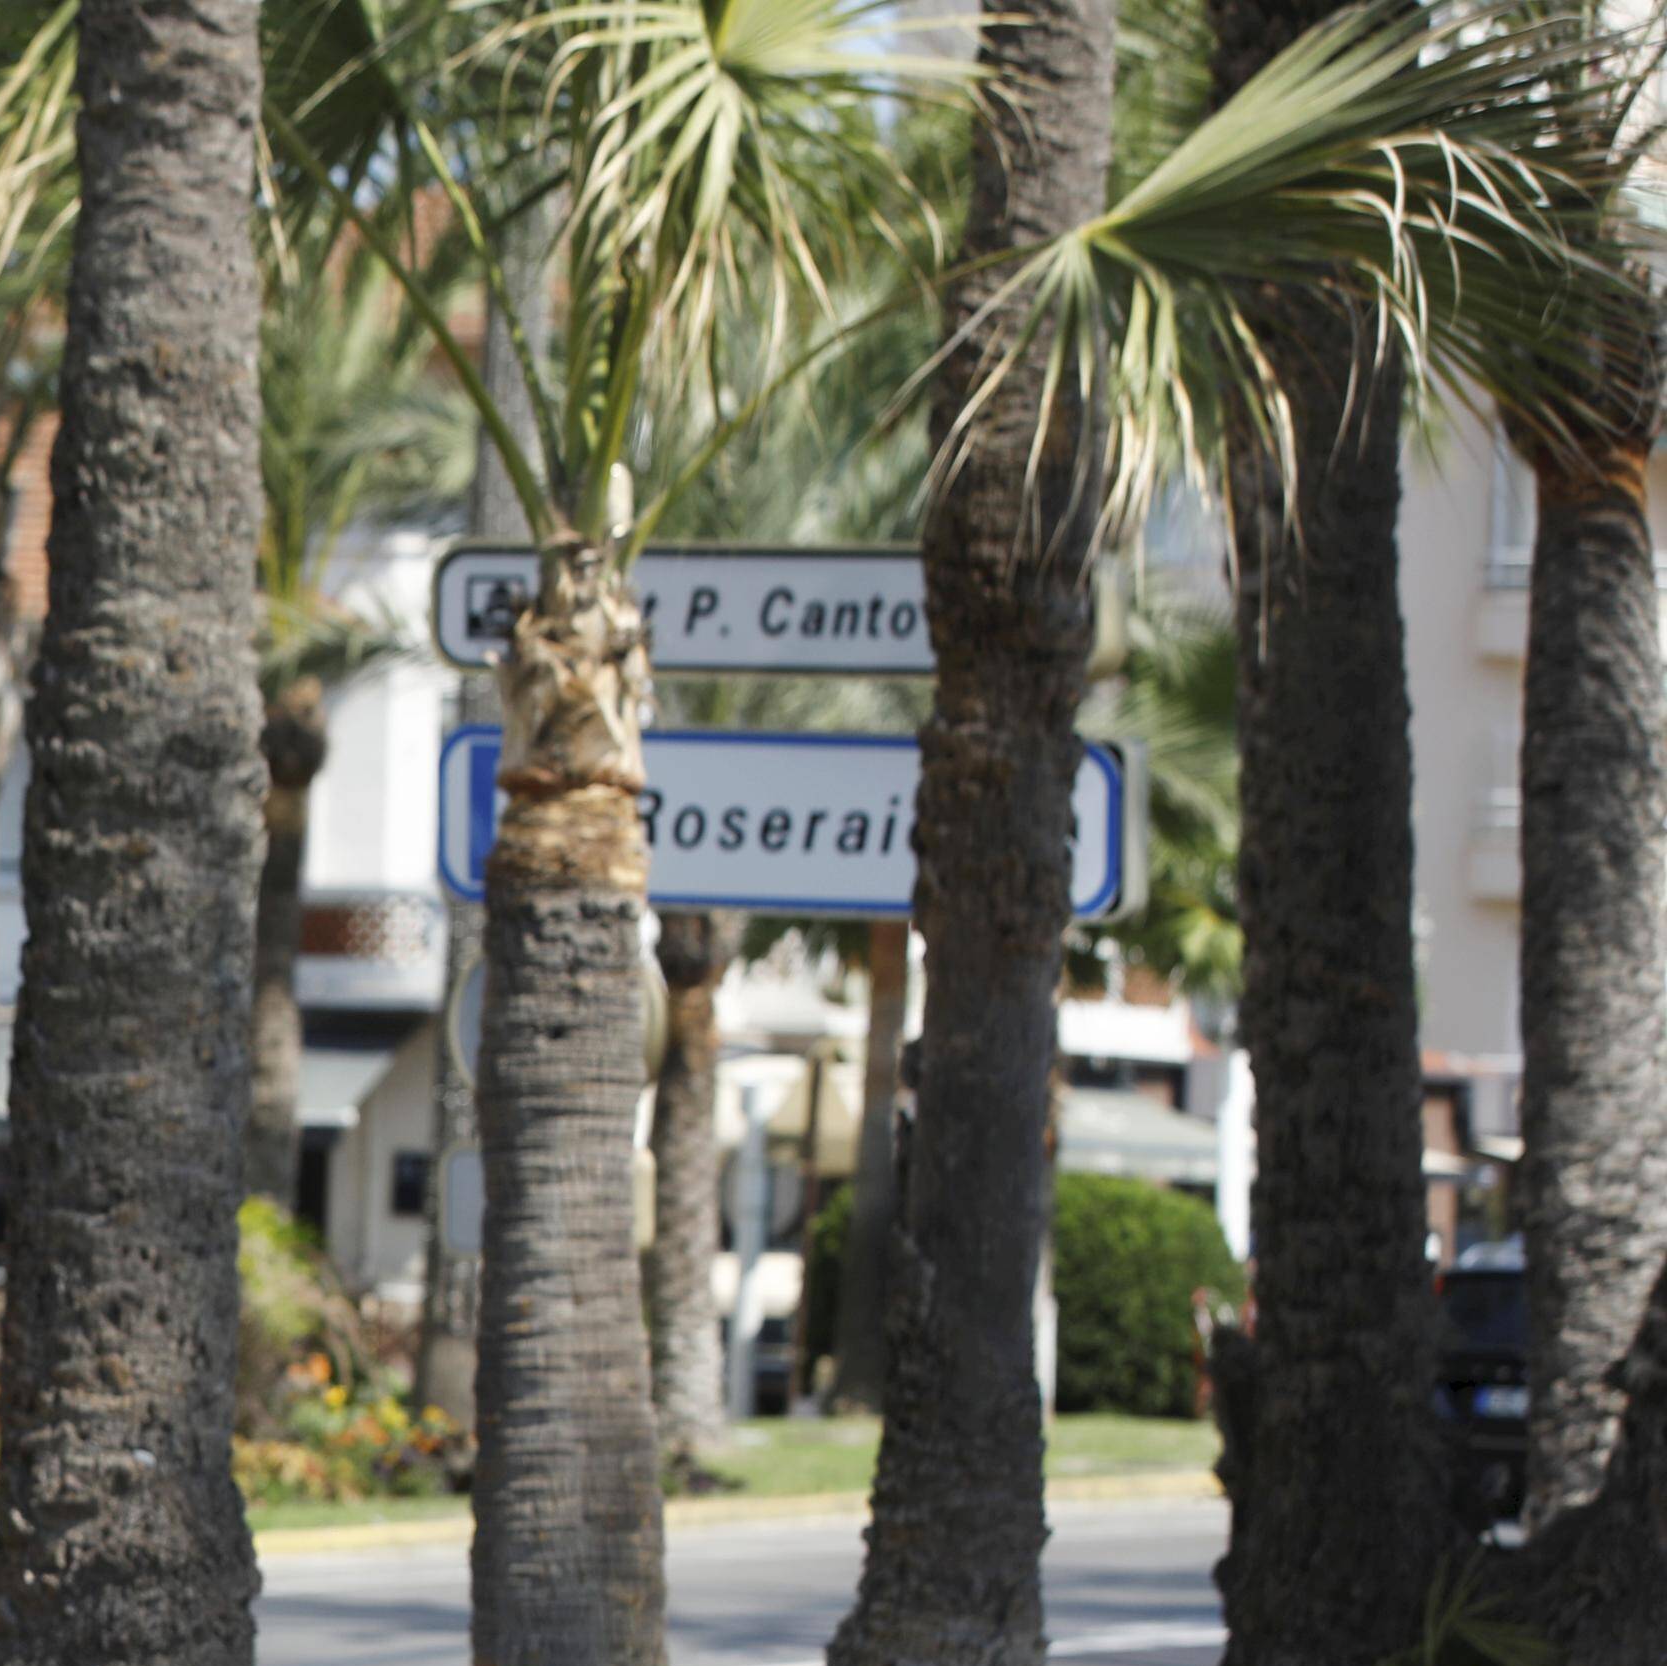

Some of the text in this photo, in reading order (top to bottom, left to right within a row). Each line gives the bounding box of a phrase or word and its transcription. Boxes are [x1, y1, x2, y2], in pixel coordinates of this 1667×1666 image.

[685, 585, 730, 638] P.
[758, 585, 918, 639] Canto
[636, 787, 923, 854] Roserai
